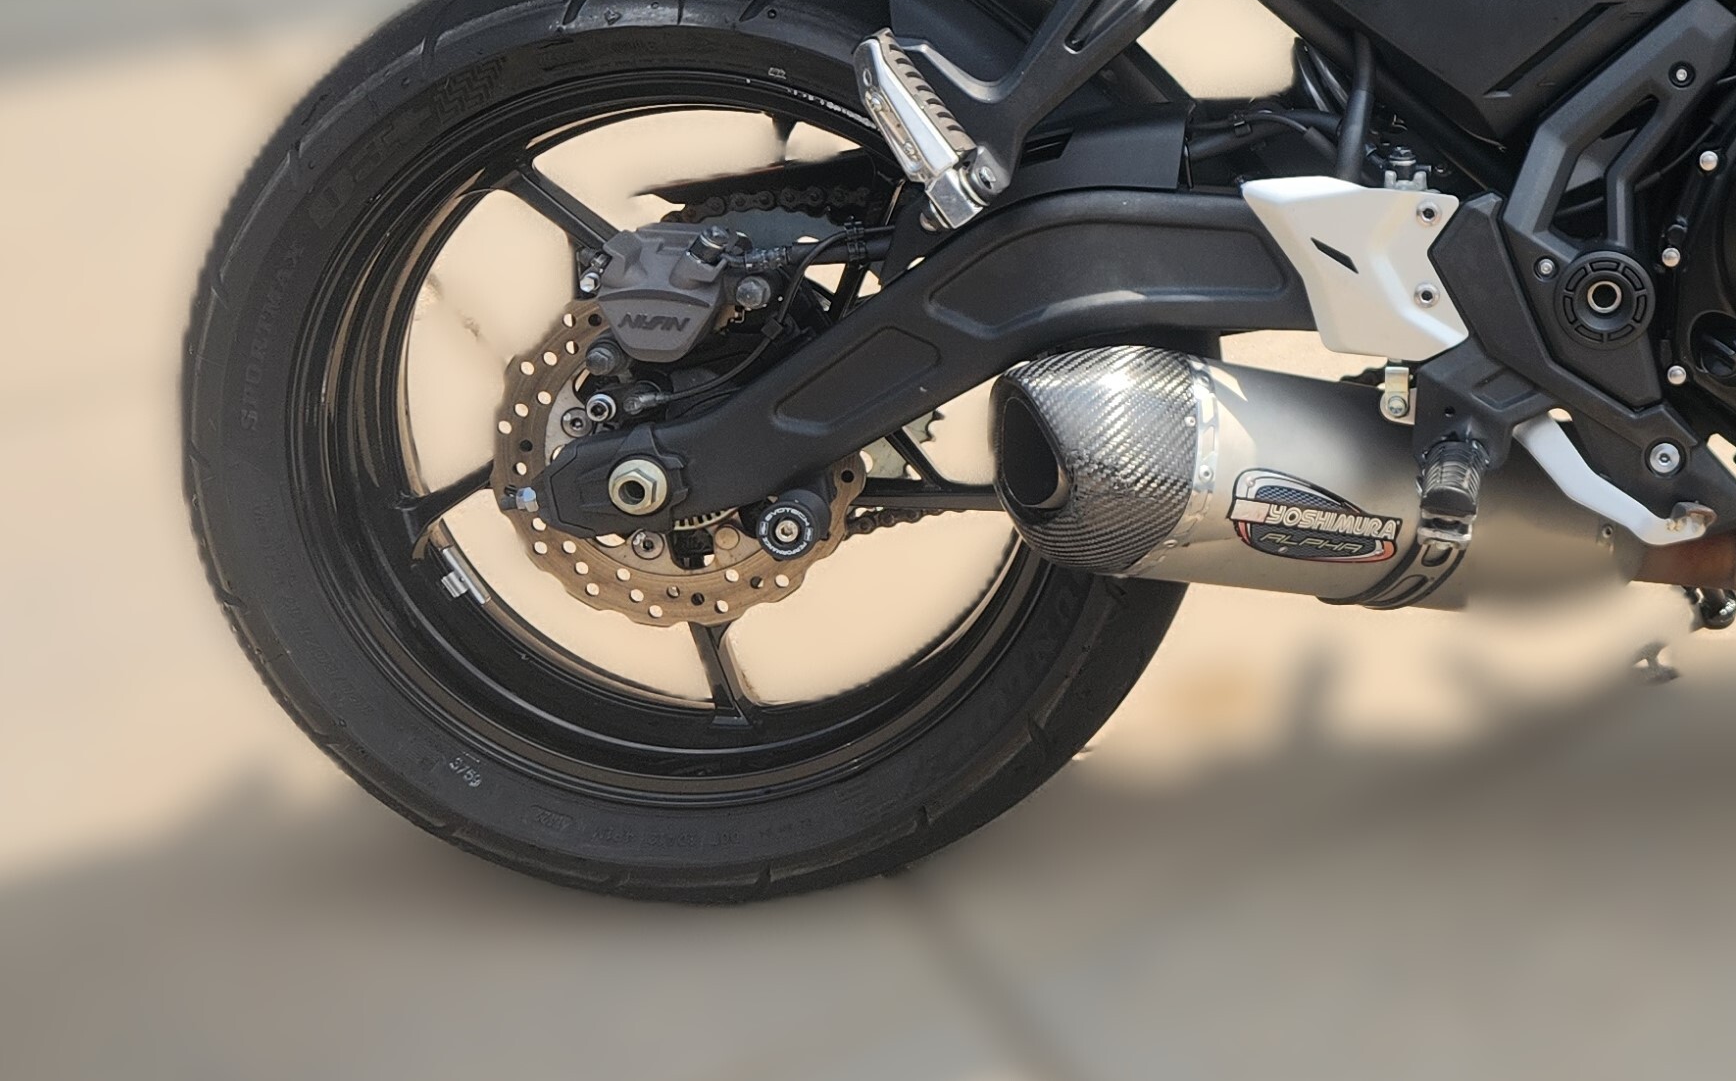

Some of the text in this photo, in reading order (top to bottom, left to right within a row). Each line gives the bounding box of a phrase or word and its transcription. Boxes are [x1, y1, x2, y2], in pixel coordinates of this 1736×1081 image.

[765, 507, 809, 526] EVOTECH
[1264, 504, 1396, 540] YOSHIMURA
[1260, 532, 1363, 554] ALPHA
